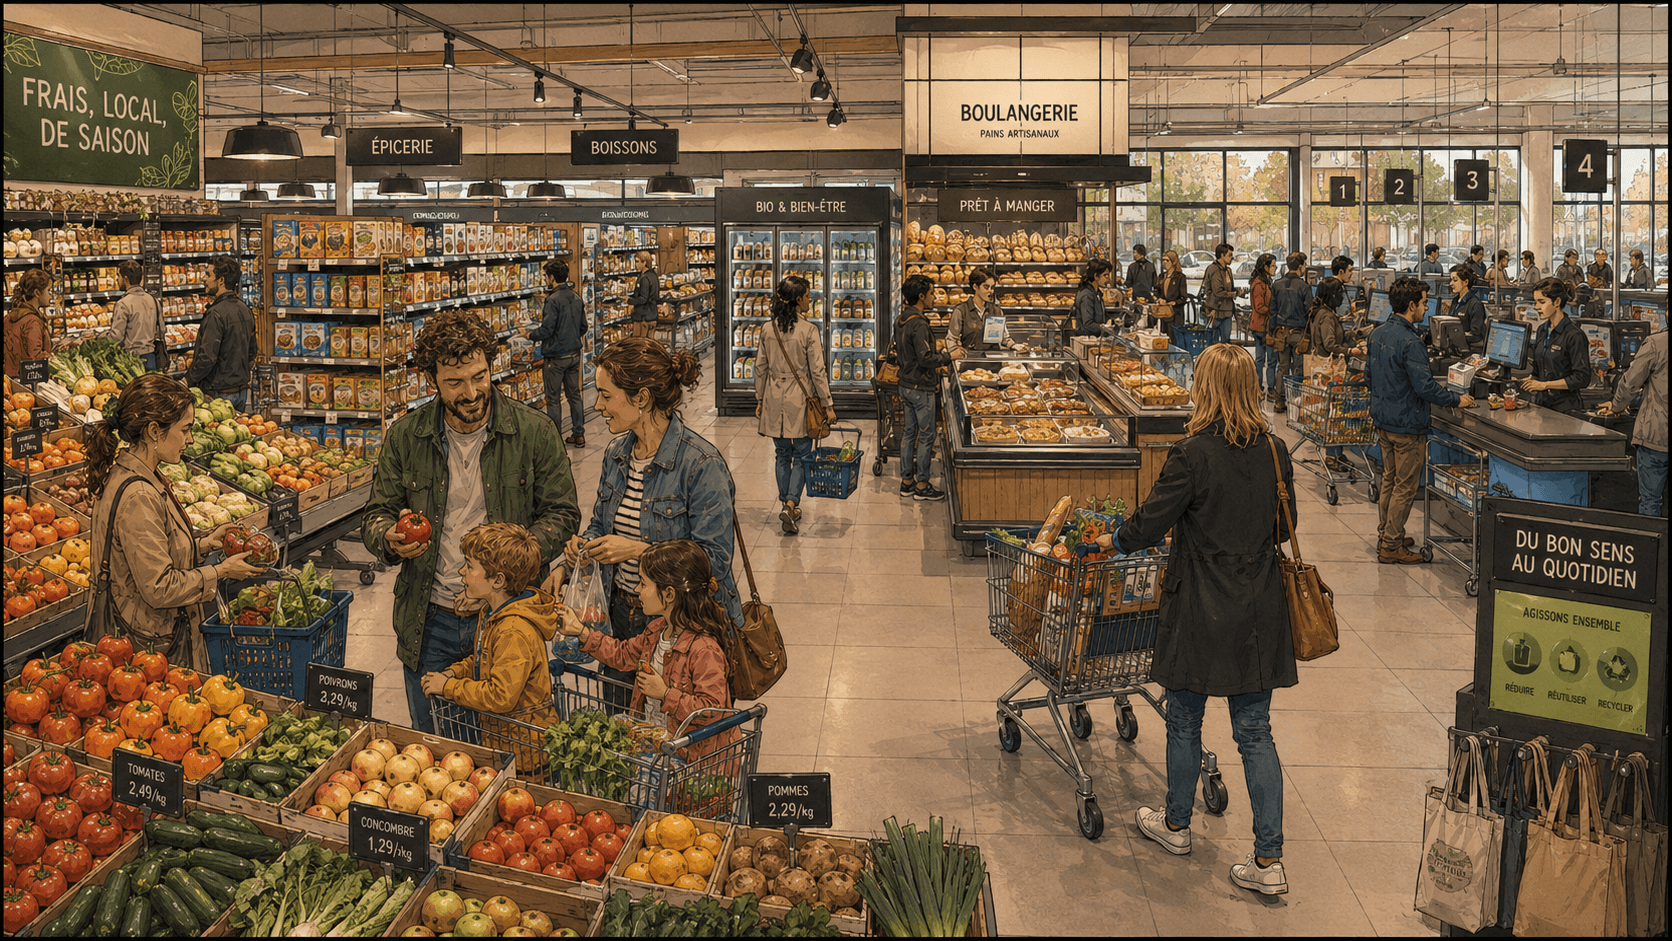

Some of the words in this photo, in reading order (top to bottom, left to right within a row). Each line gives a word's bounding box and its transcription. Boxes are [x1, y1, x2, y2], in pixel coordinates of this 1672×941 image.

[22, 76, 94, 119] FRAIS,
[103, 90, 167, 129] LOCAL,
[961, 103, 1079, 122] BOULANGERIE
[41, 118, 69, 148] DE
[78, 123, 150, 156] SAISON
[980, 129, 1005, 138] PAINS
[1007, 129, 1060, 138] ARTISANAUX
[371, 135, 434, 155] ÉPICERIE
[591, 140, 658, 155] BOISSONS
[1577, 153, 1594, 179] 4
[1393, 178, 1405, 195] 2
[1466, 170, 1479, 190] 3
[1339, 184, 1346, 199] 1
[756, 201, 774, 213] BIO
[778, 201, 786, 213] &
[993, 196, 1002, 212] À
[1006, 200, 1055, 212] MANGER
[1515, 529, 1539, 550] DU
[1546, 534, 1582, 557] BON
[1589, 540, 1635, 564] SENS
[1511, 553, 1535, 574] AU
[1542, 557, 1637, 590] QUOTIDIEN
[1522, 606, 1569, 624] AGISSONS
[1572, 614, 1621, 632] ENSEMBLE
[319, 674, 358, 691] POIVRONS
[1505, 681, 1535, 696] RÉDUIRE
[1597, 699, 1634, 713] RECYCLER
[127, 762, 166, 783] TOMATES
[128, 780, 167, 807] 2,49/kg
[768, 785, 809, 797] POMMES
[768, 802, 814, 820] 2,29/kg
[361, 816, 415, 838] CONCOMBRE
